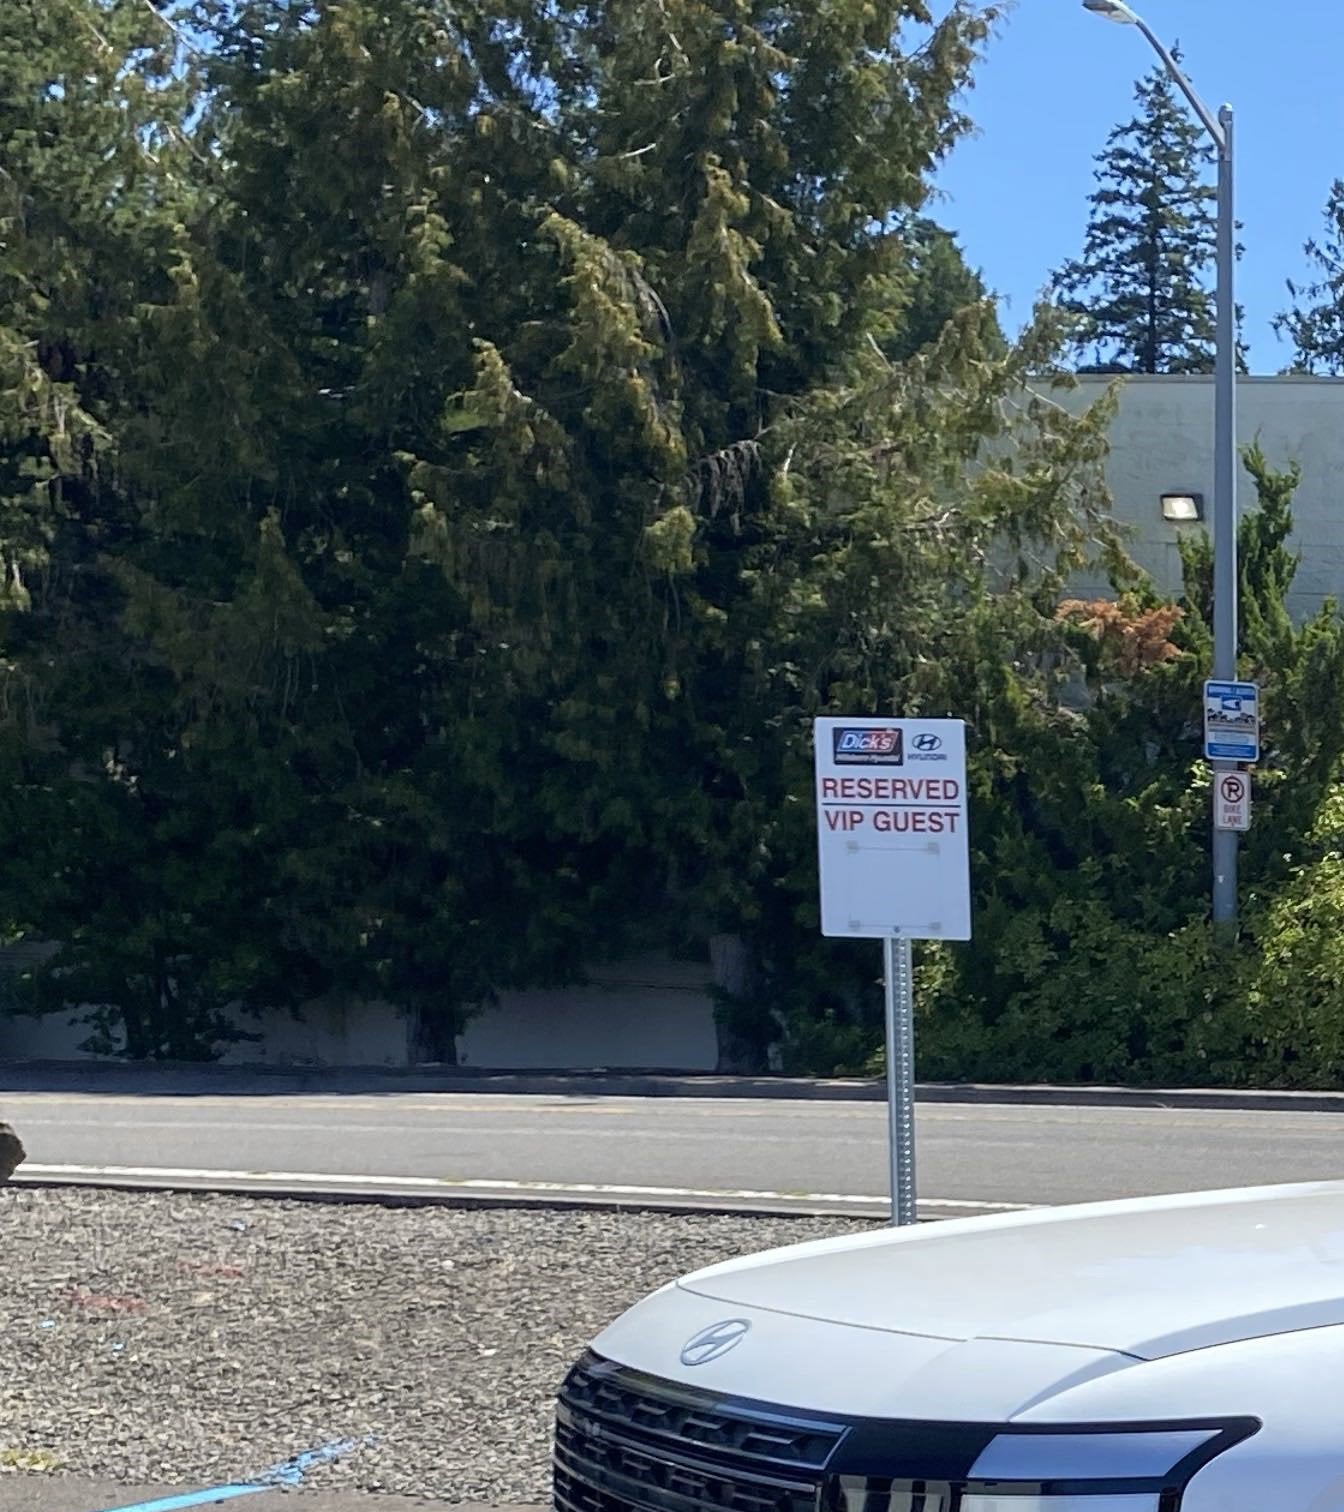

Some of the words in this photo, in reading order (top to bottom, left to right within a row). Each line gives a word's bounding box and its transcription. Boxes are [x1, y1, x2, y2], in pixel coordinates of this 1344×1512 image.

[842, 733, 893, 750] Dick's
[822, 777, 960, 801] RESERVED
[824, 809, 865, 832] VIP
[872, 810, 961, 834] GUEST
